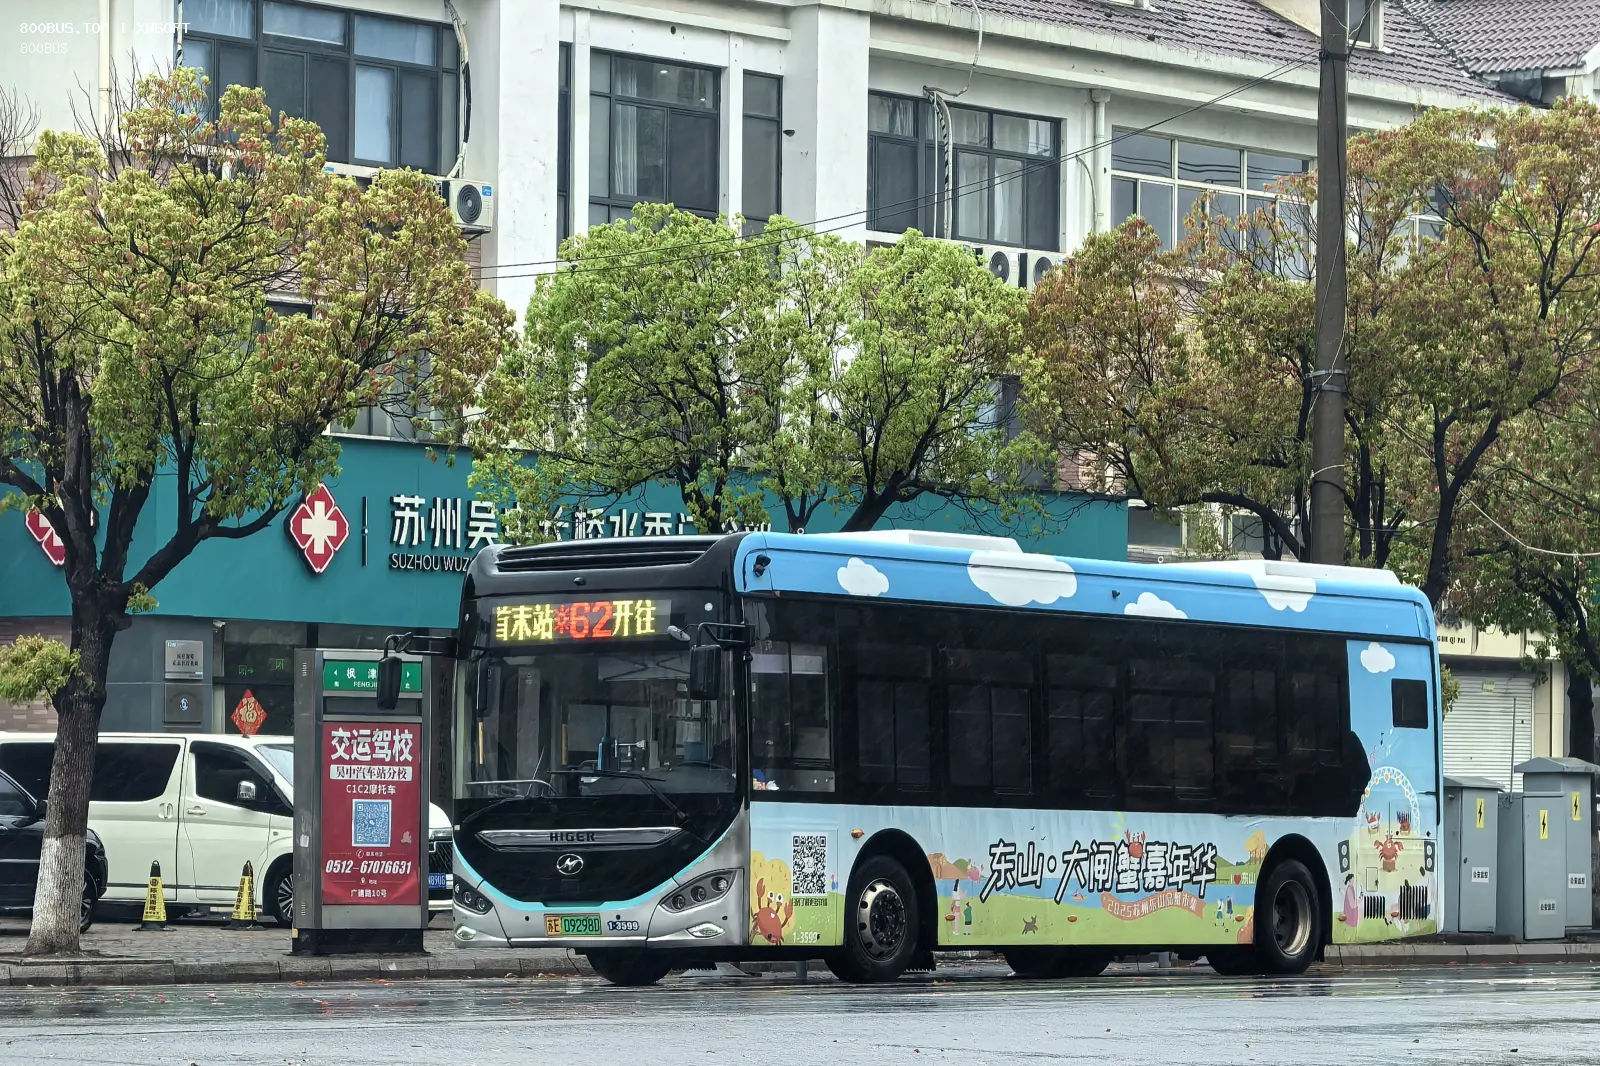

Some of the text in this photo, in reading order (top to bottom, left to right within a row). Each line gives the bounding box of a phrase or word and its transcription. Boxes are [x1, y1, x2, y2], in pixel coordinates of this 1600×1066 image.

[391, 552, 474, 573] SUZHOU WUZ
[239, 696, 257, 723] 福
[330, 727, 414, 763] 交运驾校
[335, 765, 408, 781] 吴中汽车站分校
[549, 831, 596, 842] HIGER
[325, 859, 412, 875] 0512-67076631
[792, 931, 818, 944] 1-3599
